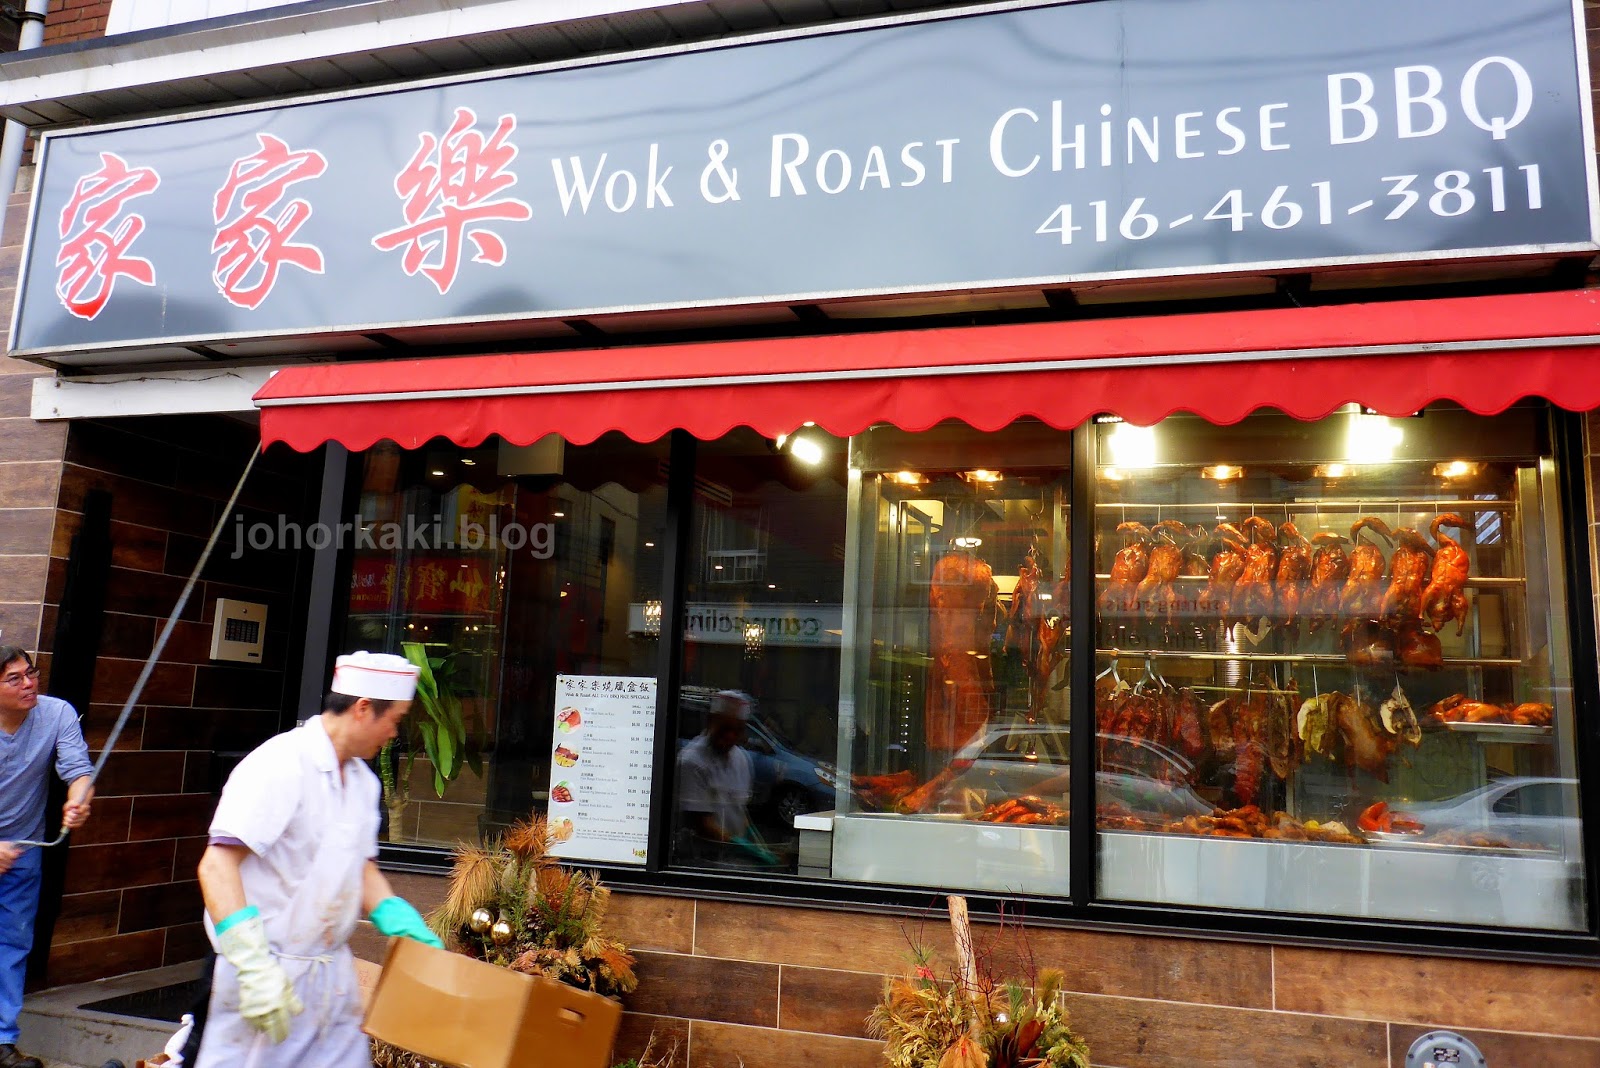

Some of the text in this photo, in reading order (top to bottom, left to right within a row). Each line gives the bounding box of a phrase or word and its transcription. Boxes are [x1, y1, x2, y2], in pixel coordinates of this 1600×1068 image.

[55, 106, 533, 321] 家家樂
[551, 143, 674, 217] Wok
[699, 138, 741, 204] &
[1327, 56, 1534, 145] BBQ
[1035, 163, 1543, 246] 416-461-3811
